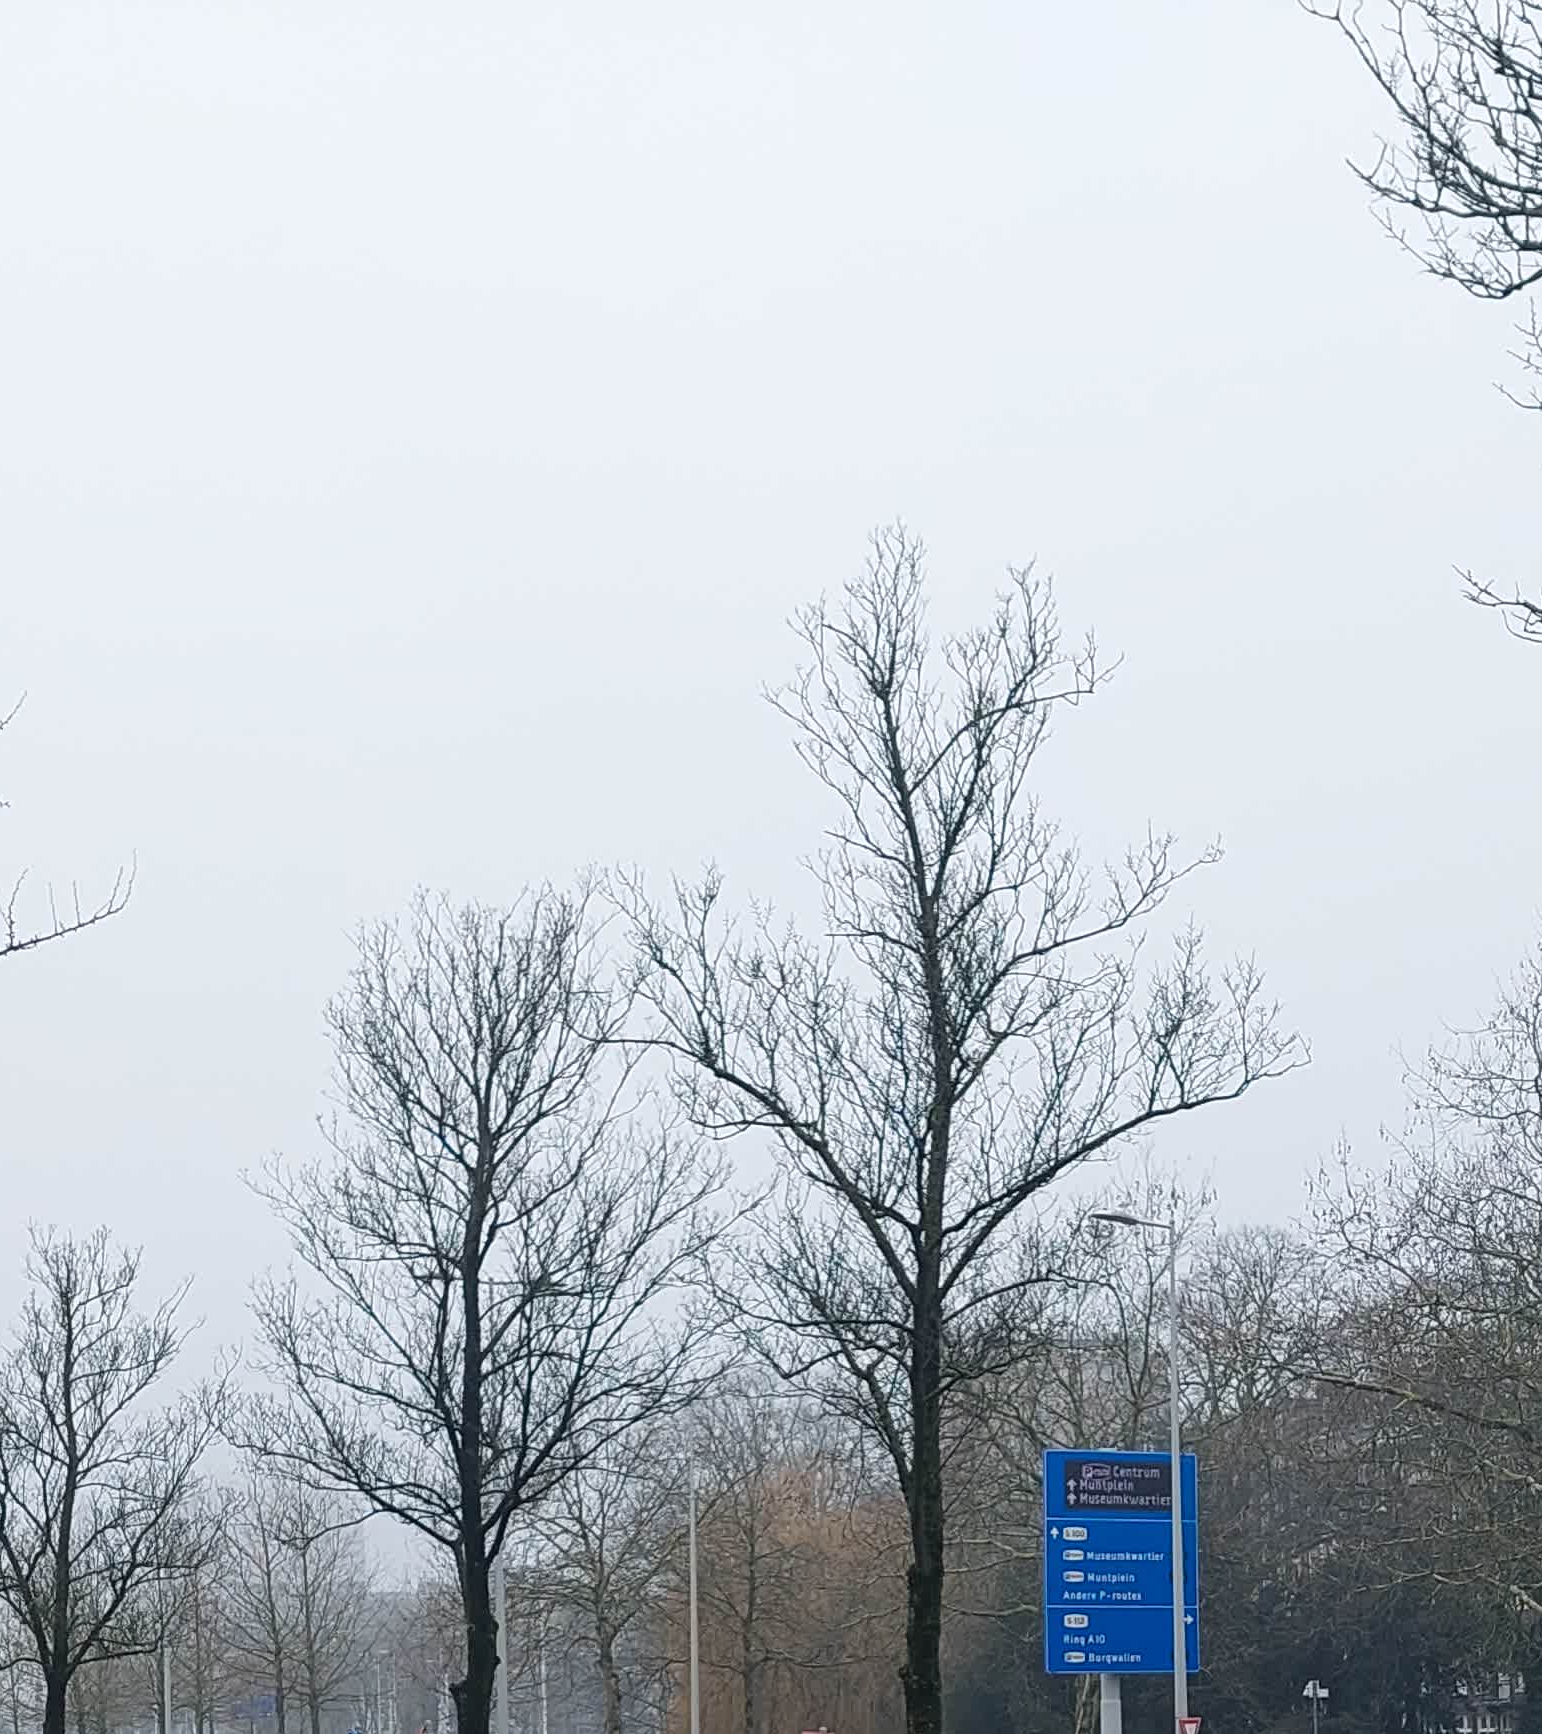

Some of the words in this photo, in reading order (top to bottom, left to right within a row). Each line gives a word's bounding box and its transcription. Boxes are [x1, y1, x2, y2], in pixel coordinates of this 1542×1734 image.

[1113, 1465, 1160, 1478] Centrum
[1079, 1480, 1134, 1492] Muntplein
[1079, 1493, 1171, 1505] Museumkwartier
[1086, 1551, 1164, 1561] Museumkwartier
[1087, 1573, 1135, 1583] Muntplein
[1063, 1590, 1096, 1600] Andere
[1063, 1634, 1085, 1646] Ring
[1087, 1634, 1106, 1644] A10
